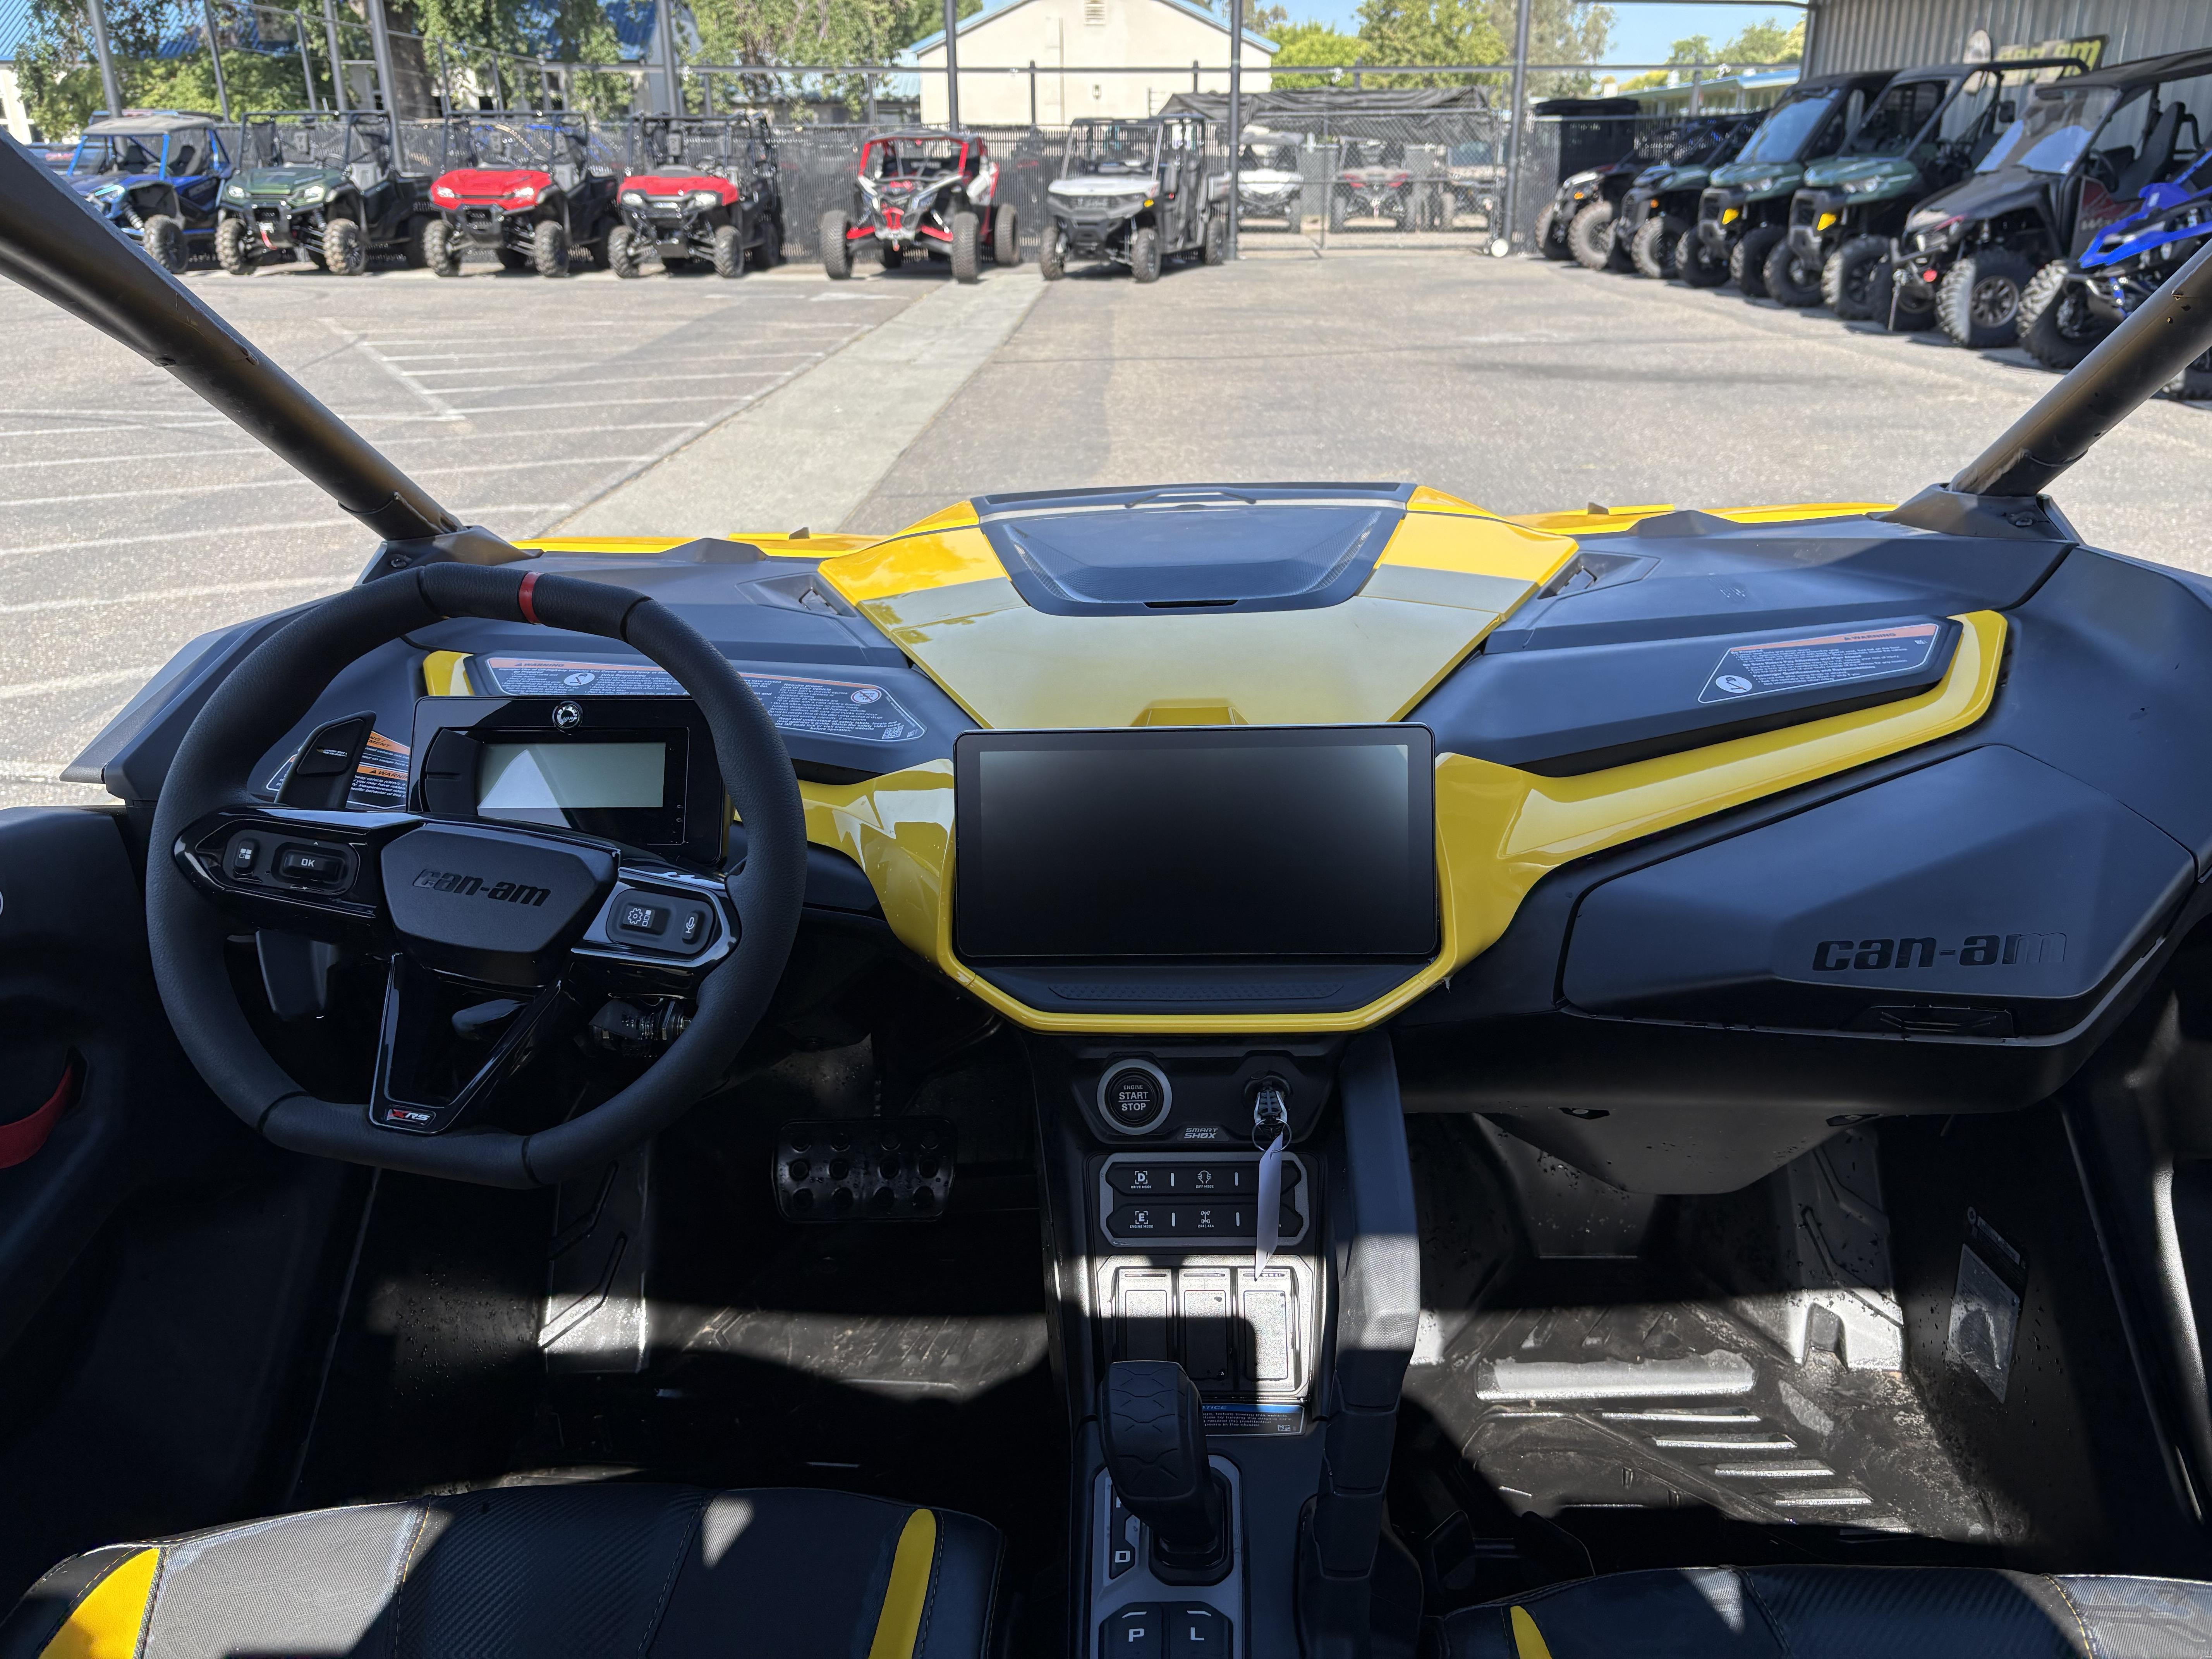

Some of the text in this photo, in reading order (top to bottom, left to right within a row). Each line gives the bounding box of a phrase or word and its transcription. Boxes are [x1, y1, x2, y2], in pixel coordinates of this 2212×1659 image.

[301, 858, 316, 867] OK
[412, 869, 551, 907] can-am
[1812, 932, 2067, 971] can-am
[1121, 1103, 1146, 1111] STOP
[1115, 1551, 1130, 1562] D
[1128, 1628, 1144, 1642] P
[1190, 1627, 1204, 1640] L
